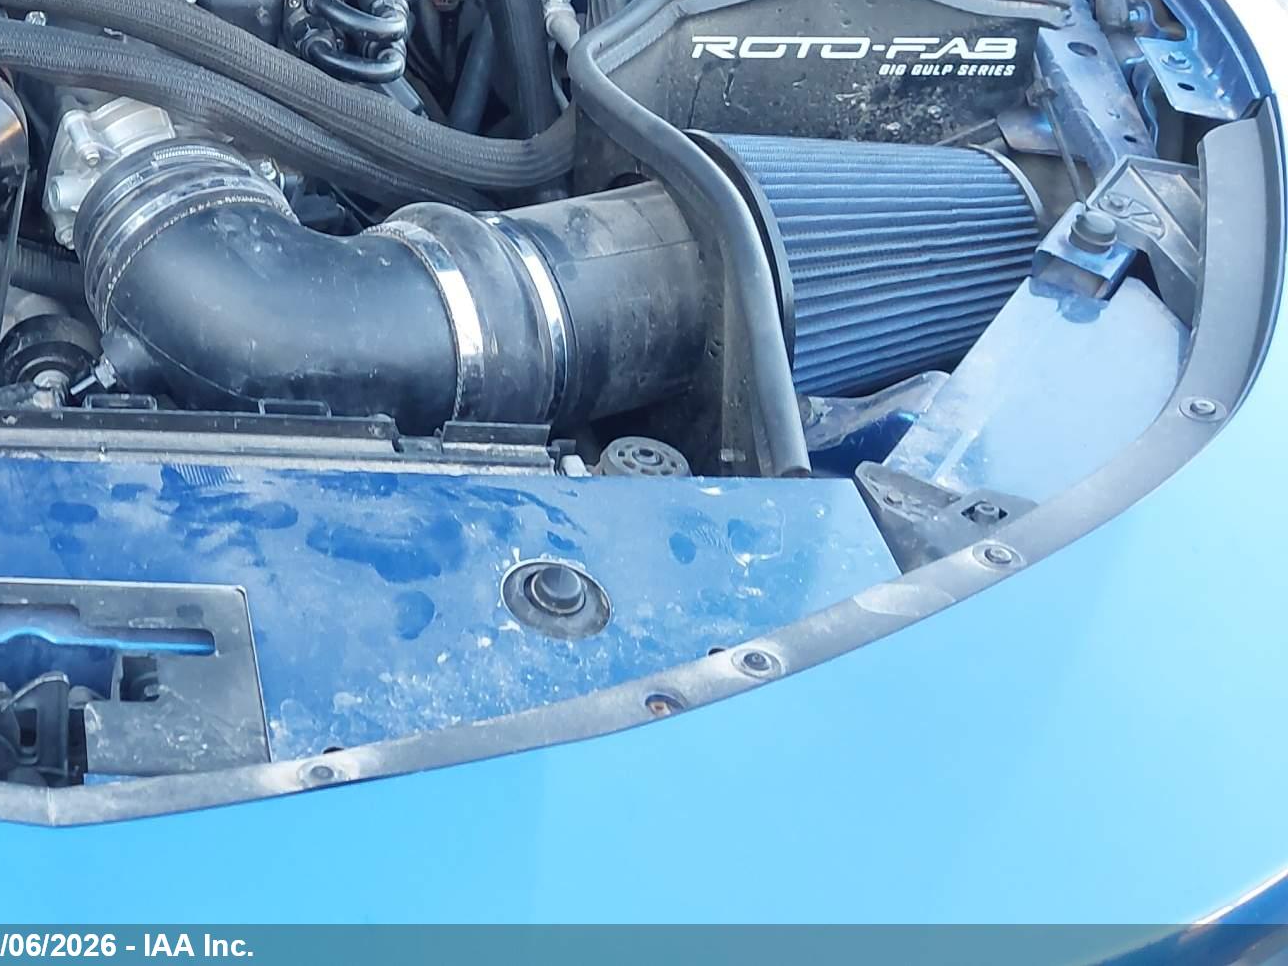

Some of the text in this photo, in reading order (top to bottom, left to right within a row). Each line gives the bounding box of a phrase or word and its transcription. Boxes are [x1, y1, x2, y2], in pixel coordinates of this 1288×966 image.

[691, 35, 1017, 60] ROTO-FAB
[878, 64, 1016, 76] BIG GULP SERIES
